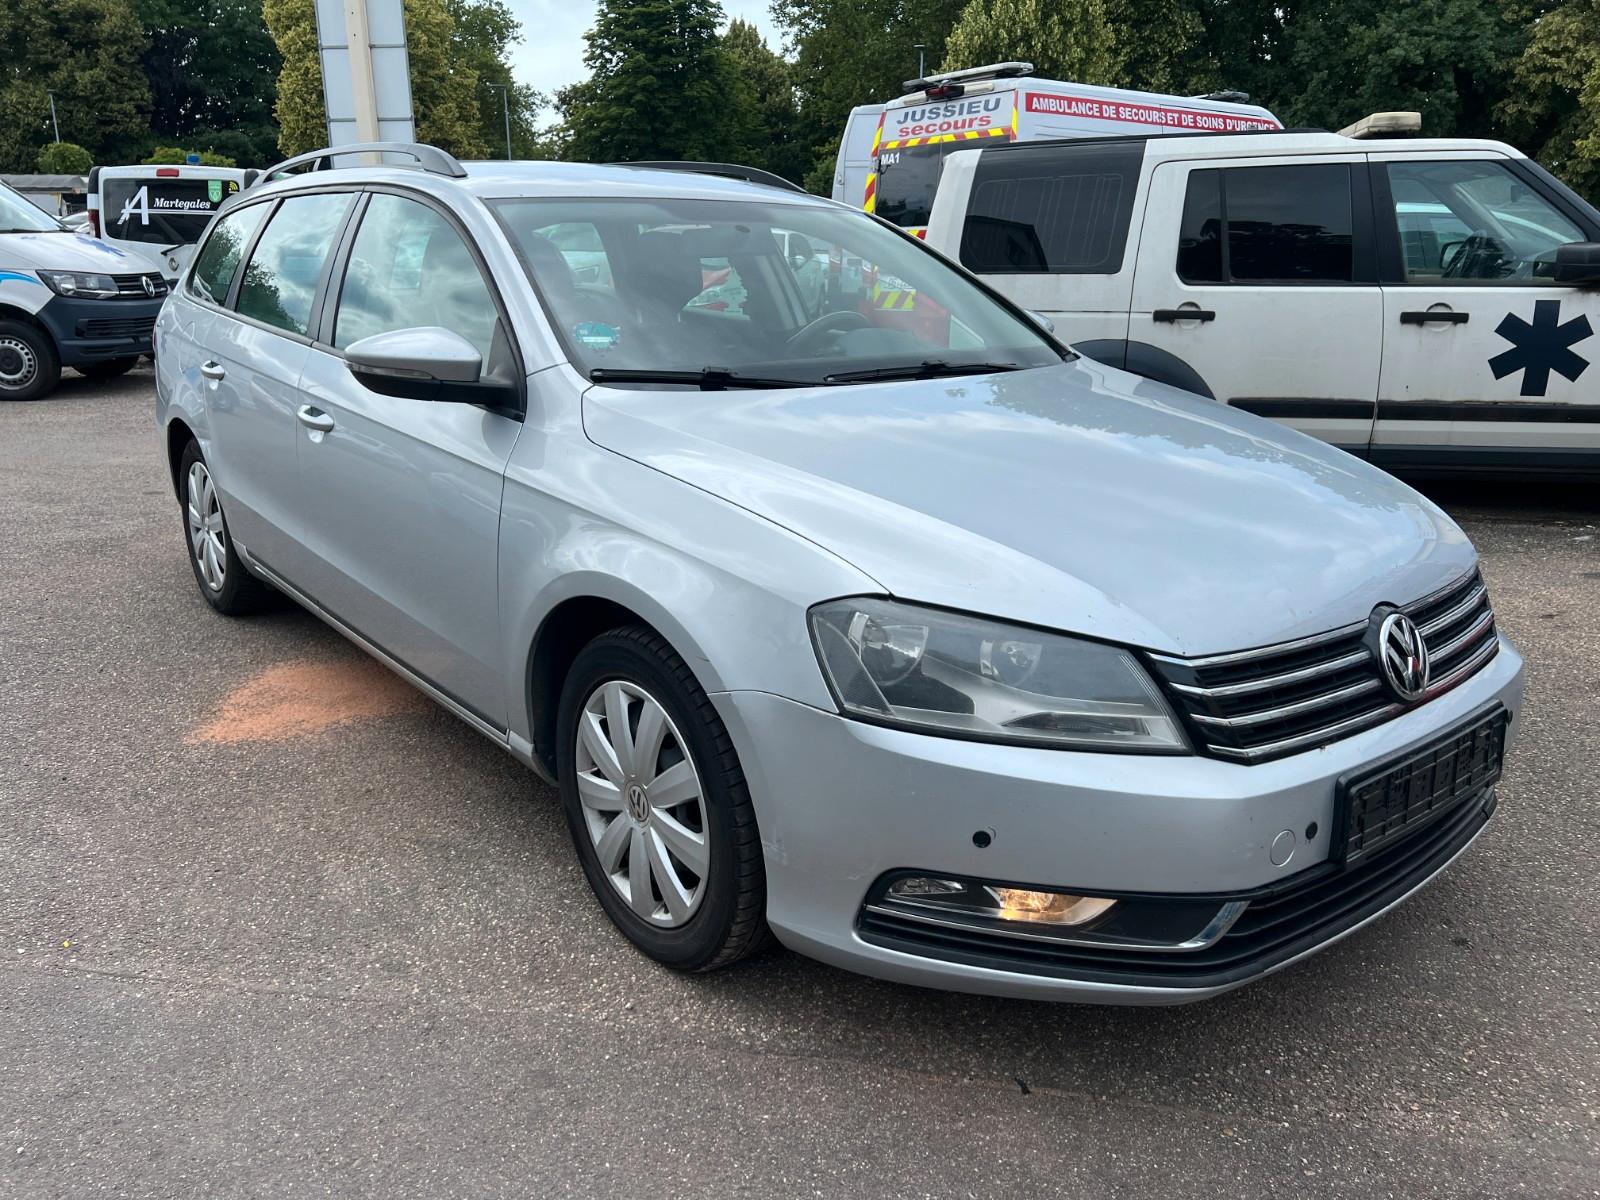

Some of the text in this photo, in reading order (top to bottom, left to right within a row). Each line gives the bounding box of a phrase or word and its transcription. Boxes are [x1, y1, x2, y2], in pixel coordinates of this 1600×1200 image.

[897, 98, 1001, 125] JUSSIEU
[1032, 97, 1275, 131] AMBULANCE DE SECOURS ET DE SOINS D'URNCE
[899, 115, 991, 137] secours
[881, 152, 900, 165] MA1
[153, 197, 211, 210] Martegales
[1380, 613, 1430, 700] VW
